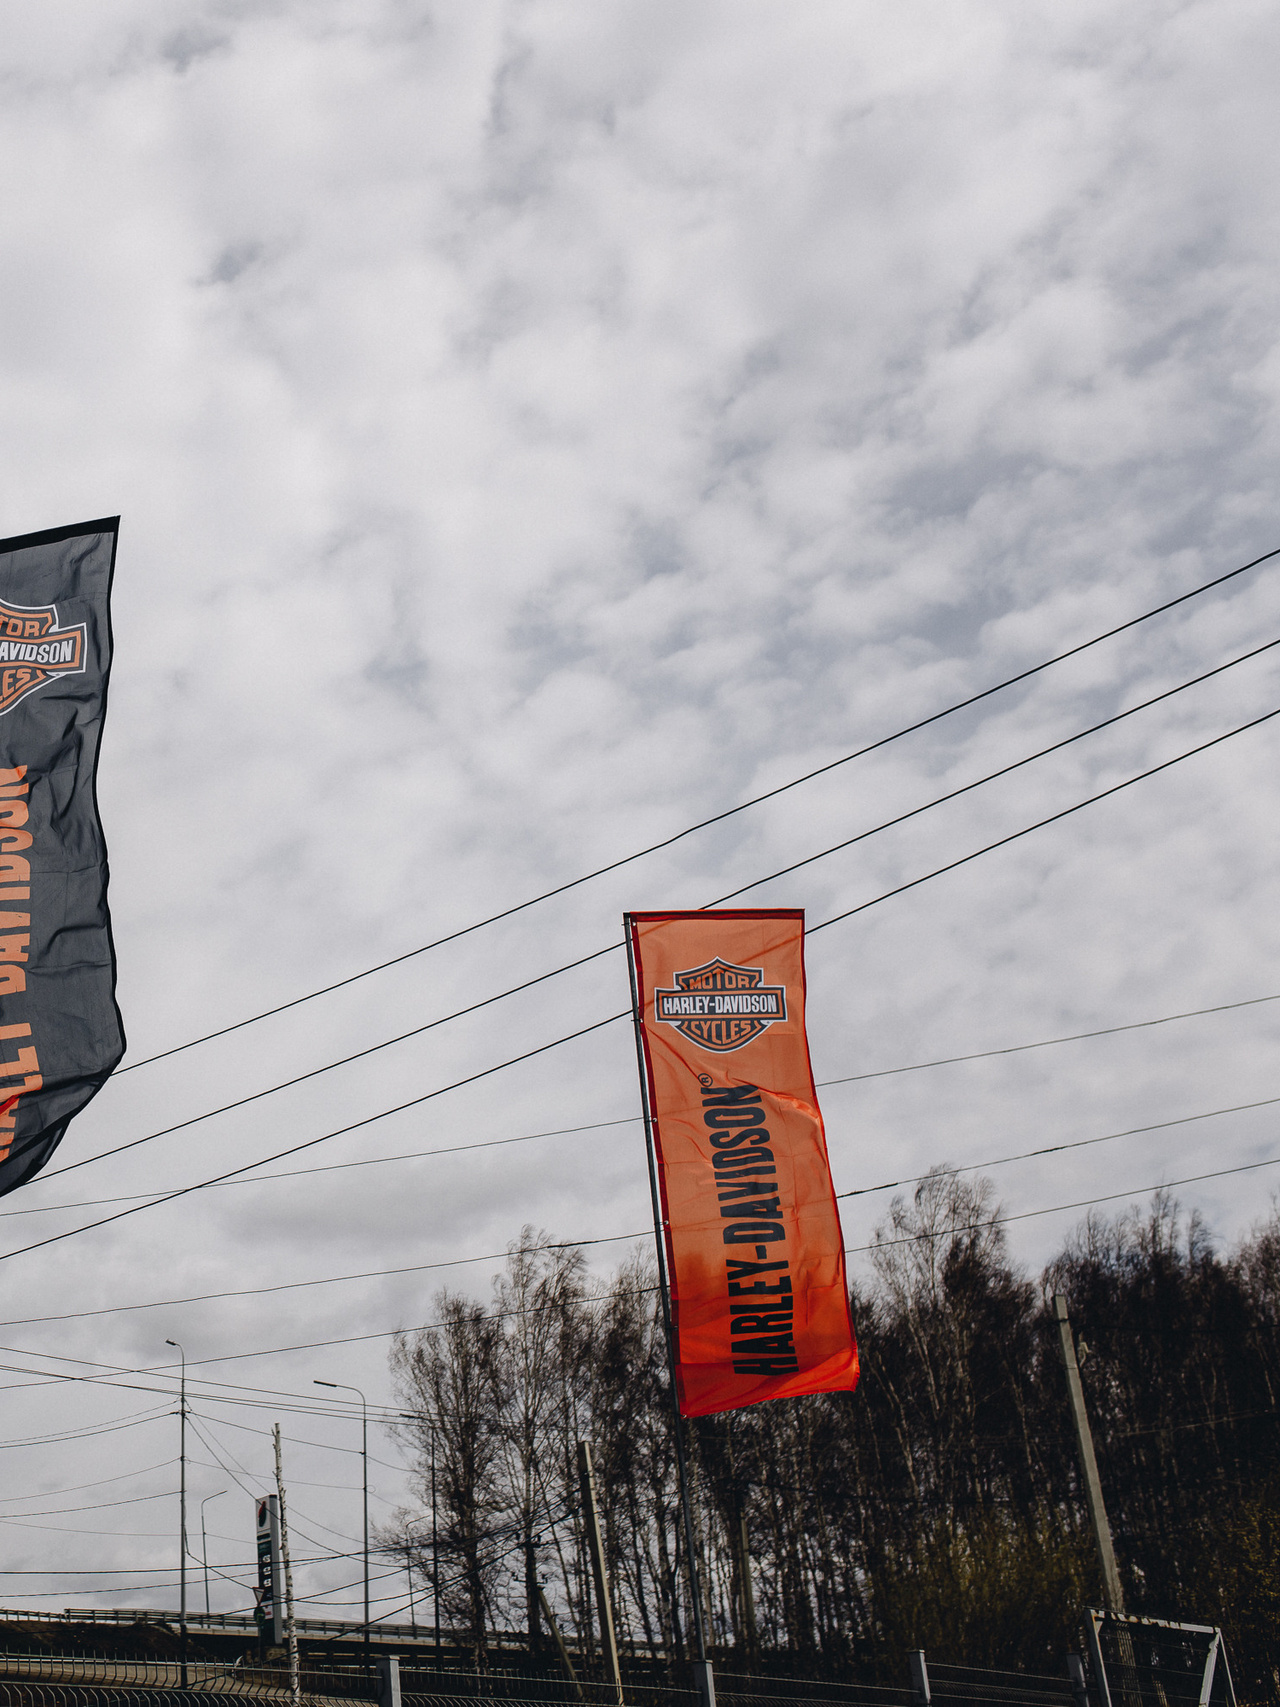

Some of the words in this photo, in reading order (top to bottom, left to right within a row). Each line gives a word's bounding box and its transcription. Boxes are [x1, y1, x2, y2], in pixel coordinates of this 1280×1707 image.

[689, 968, 750, 990] MOTOR
[663, 994, 778, 1015] HARLEY-DAVIDSON
[690, 1020, 752, 1045] CYCLES
